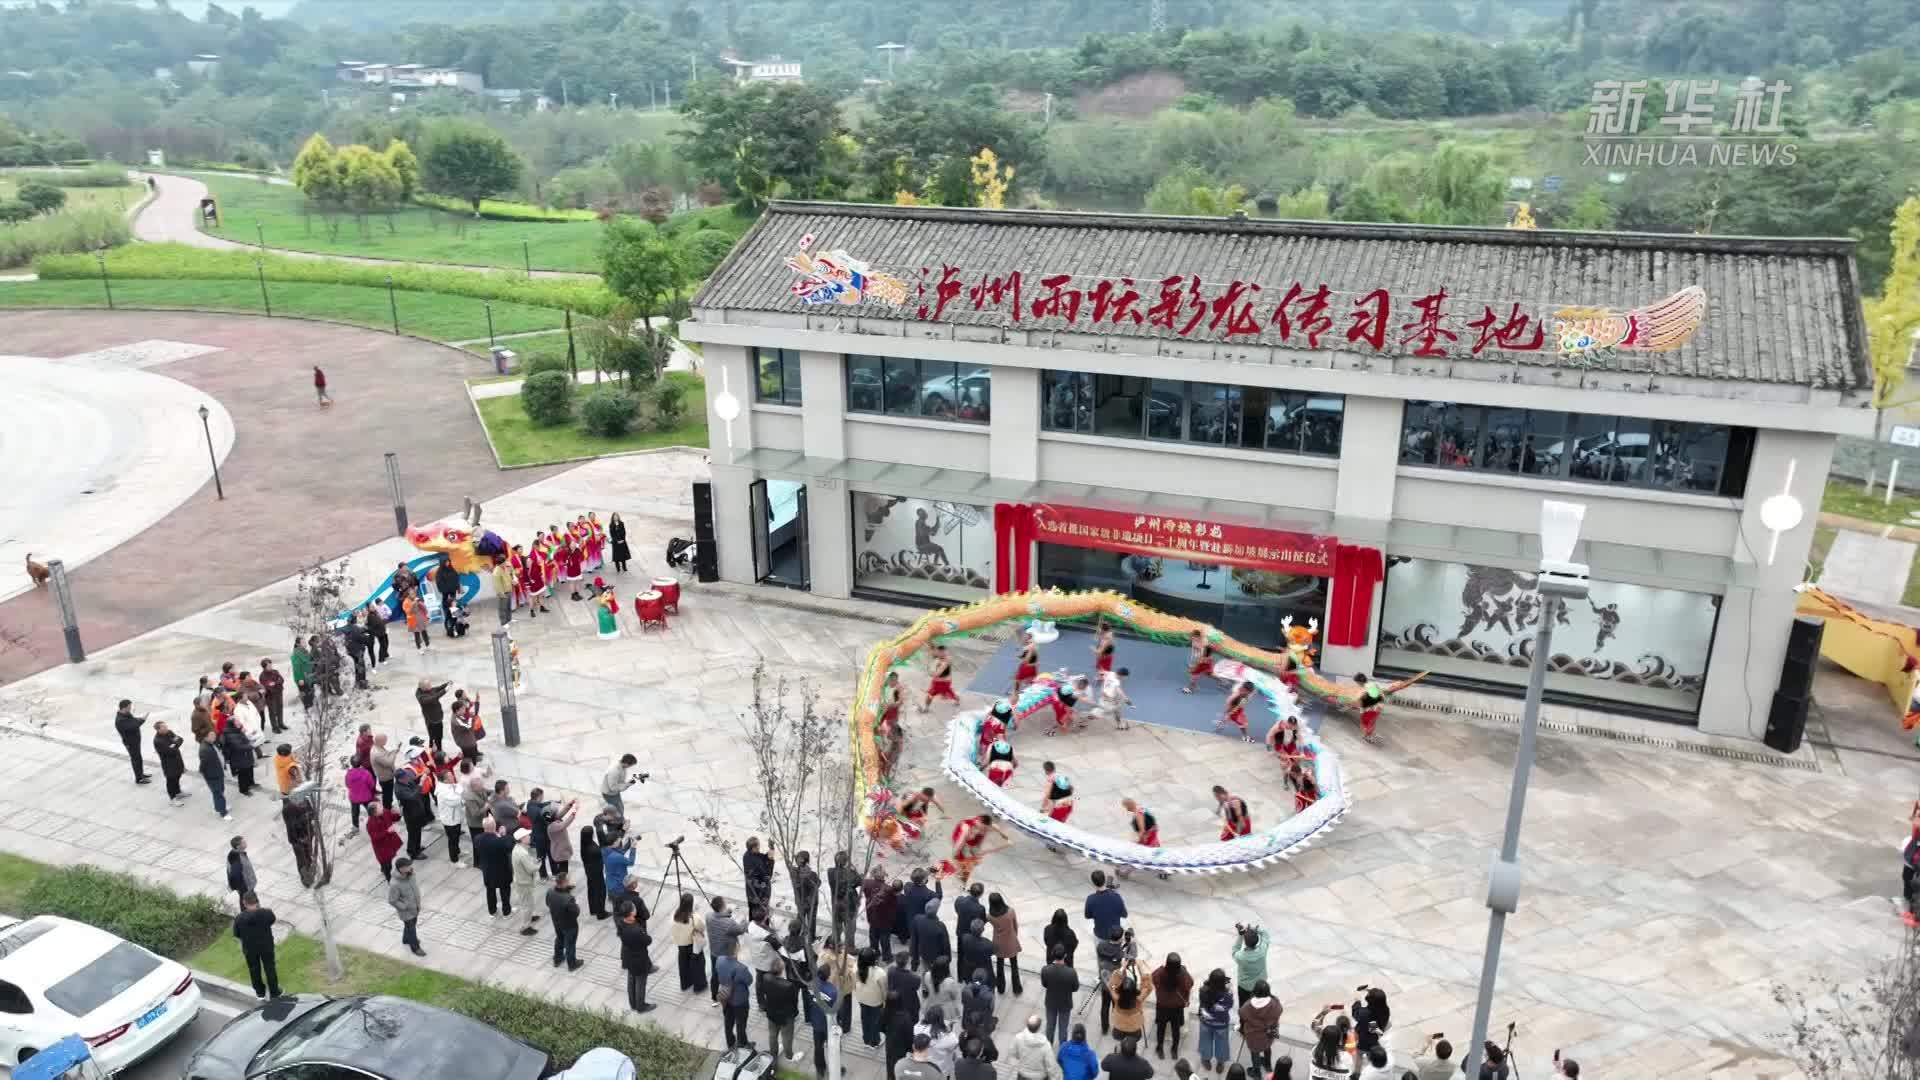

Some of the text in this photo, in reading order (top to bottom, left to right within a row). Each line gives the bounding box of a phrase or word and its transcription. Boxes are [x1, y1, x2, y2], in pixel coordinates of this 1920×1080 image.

[916, 262, 1545, 356] 泸州雨坛彩龙传习基地
